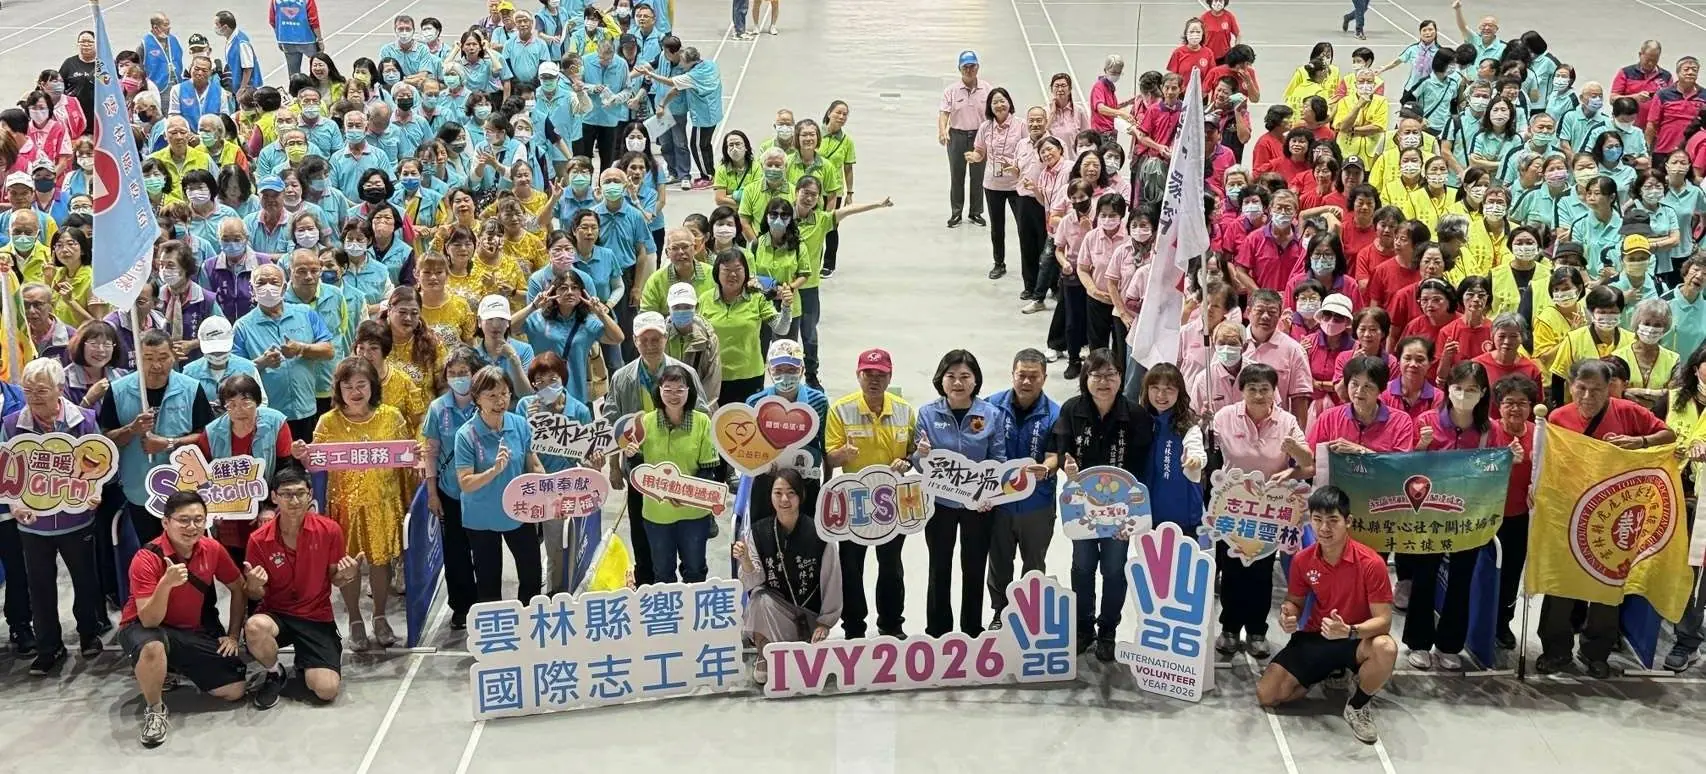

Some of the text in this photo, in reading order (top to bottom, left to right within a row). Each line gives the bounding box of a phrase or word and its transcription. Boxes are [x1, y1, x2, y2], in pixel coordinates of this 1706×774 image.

[31, 452, 72, 471] 溫暖
[214, 459, 250, 479] 維持
[309, 447, 389, 466] 志工服務
[0, 447, 88, 501] Warm
[521, 477, 591, 496] 志願奉獻
[150, 468, 265, 514] Sstain
[513, 500, 545, 519] 共創
[822, 481, 927, 529] WISH
[1225, 498, 1293, 522] 志工上場
[1215, 516, 1300, 546] 幸福雲林
[474, 585, 737, 654] 雲林縣響應
[1140, 618, 1202, 658] 26
[770, 637, 1005, 692] IVY2026
[1022, 651, 1070, 677] 26
[1119, 650, 1197, 676] INTERNATIONAL
[1135, 664, 1196, 687] VOLUNTEER
[478, 643, 739, 713] 國際志工年
[1142, 678, 1195, 698] YEAR 2026
